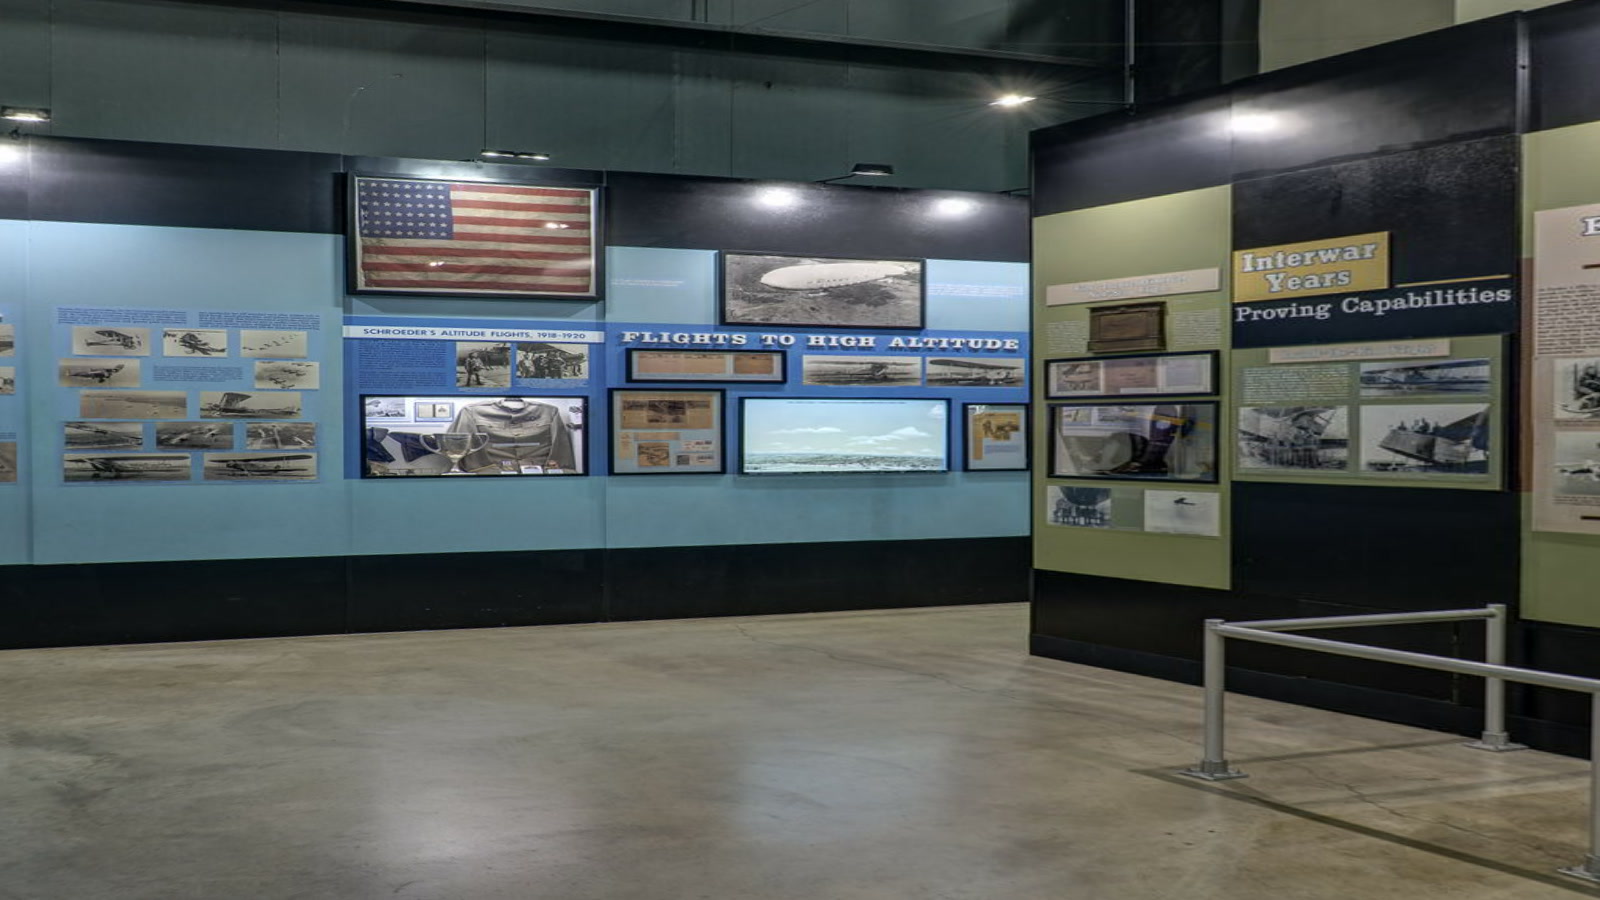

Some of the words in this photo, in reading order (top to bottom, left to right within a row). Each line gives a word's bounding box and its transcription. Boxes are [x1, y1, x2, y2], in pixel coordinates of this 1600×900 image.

[1242, 244, 1377, 273] Interwar
[1266, 271, 1350, 293] Years
[1235, 303, 1331, 322] Proving
[1341, 288, 1512, 315] Capabilities
[363, 328, 436, 336] SCHROEDER'S
[441, 330, 486, 338] ALTITUDE
[537, 332, 585, 340] 1918-1920
[621, 331, 747, 345] FLIGHTS
[763, 333, 795, 346] TO
[807, 335, 876, 348] HIGH
[889, 336, 1019, 352] ALTITUDE
